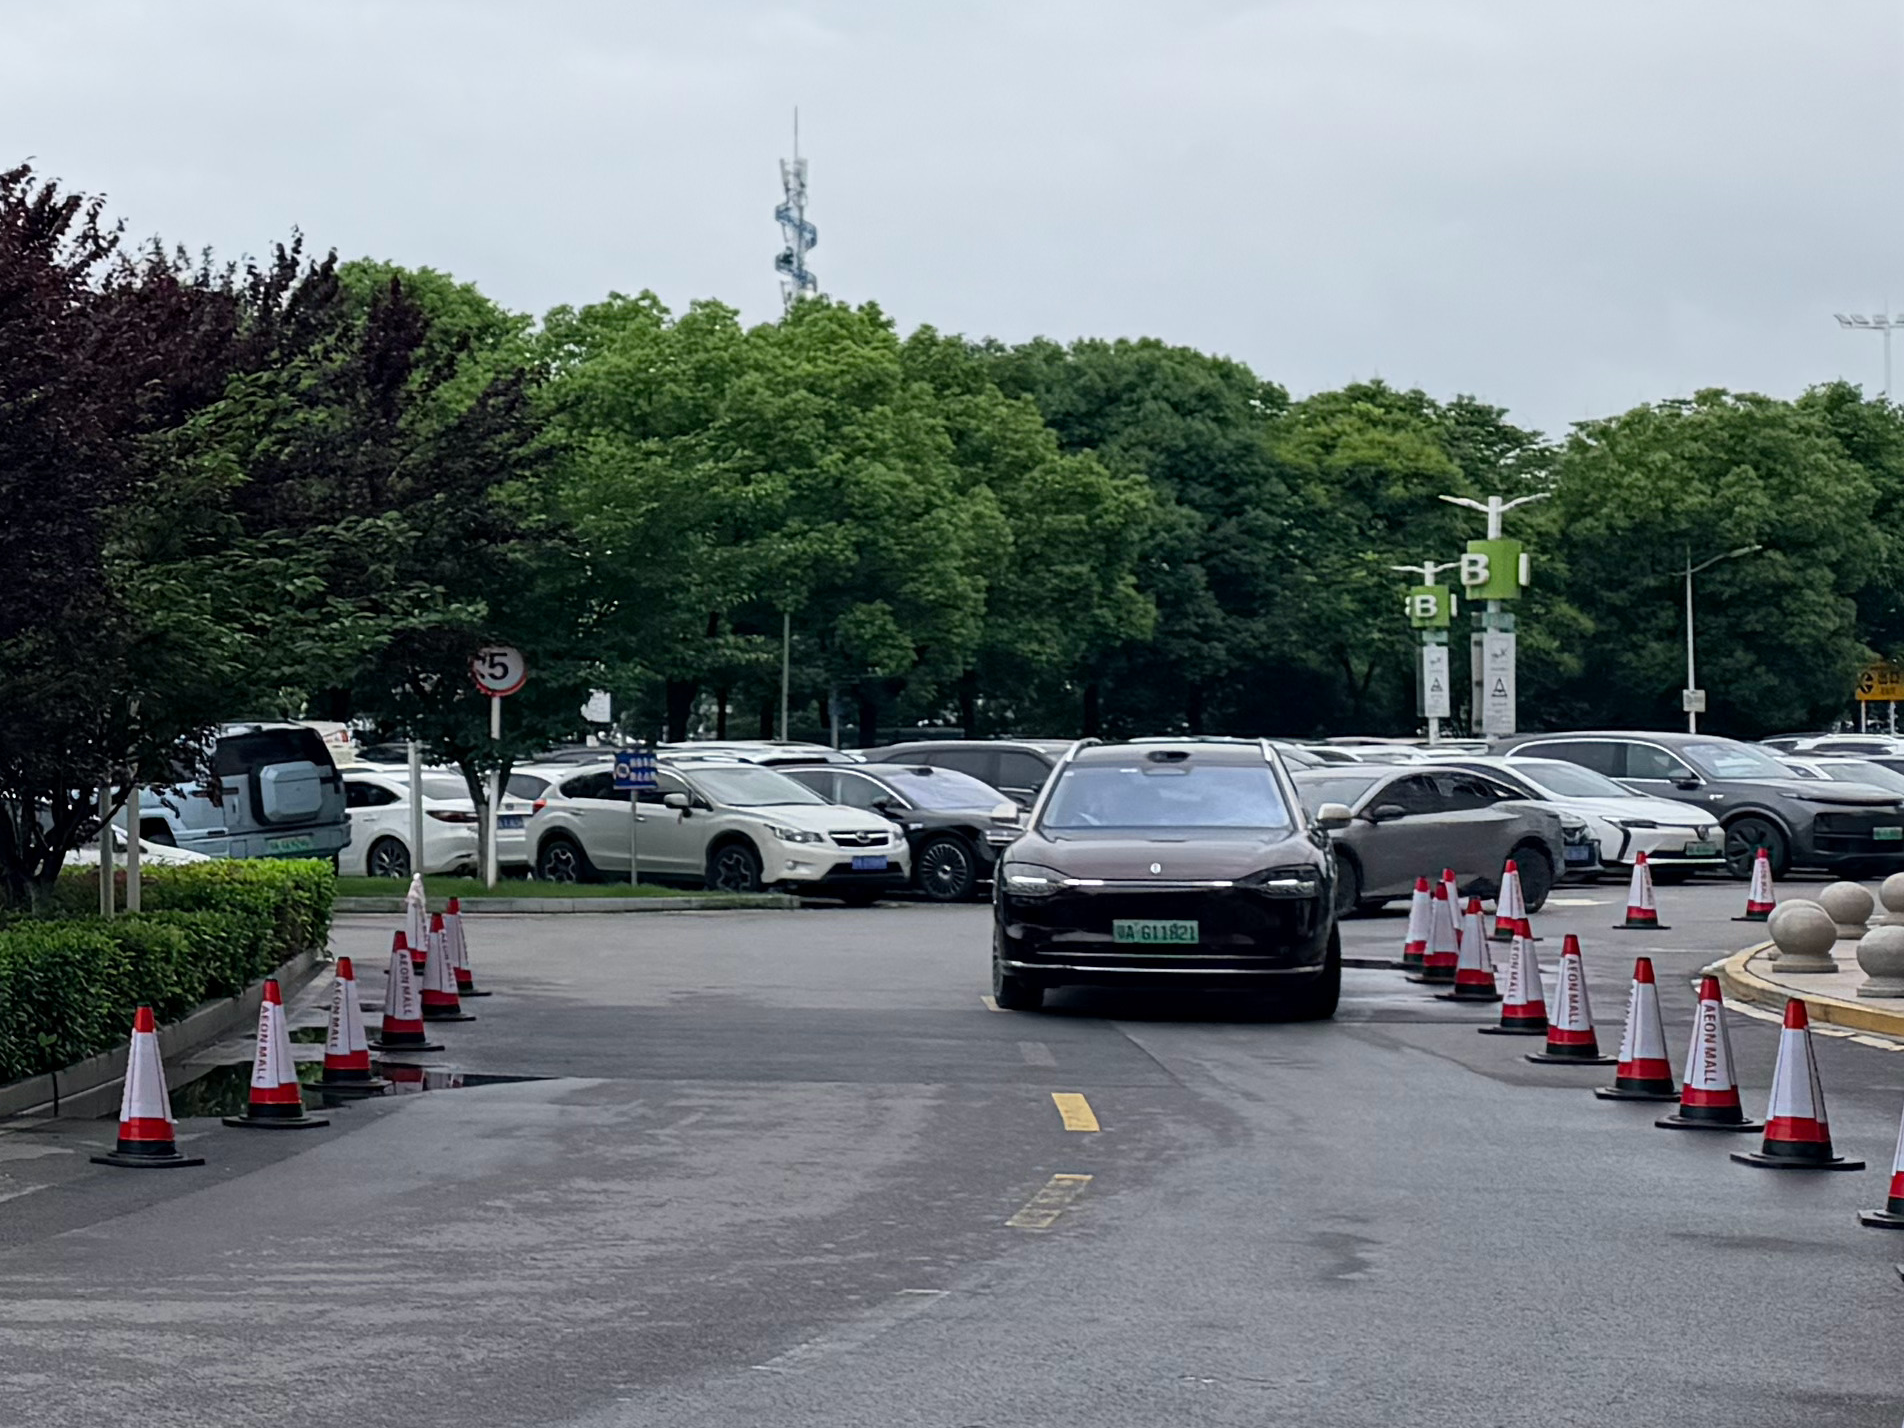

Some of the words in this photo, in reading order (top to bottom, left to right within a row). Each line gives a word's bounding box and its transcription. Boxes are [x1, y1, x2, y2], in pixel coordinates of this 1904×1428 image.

[1460, 553, 1490, 586] B
[1415, 594, 1438, 617] B
[1568, 993, 1580, 1026] MALL
[1703, 1004, 1717, 1043] AEON
[1703, 1047, 1717, 1085] MALL
